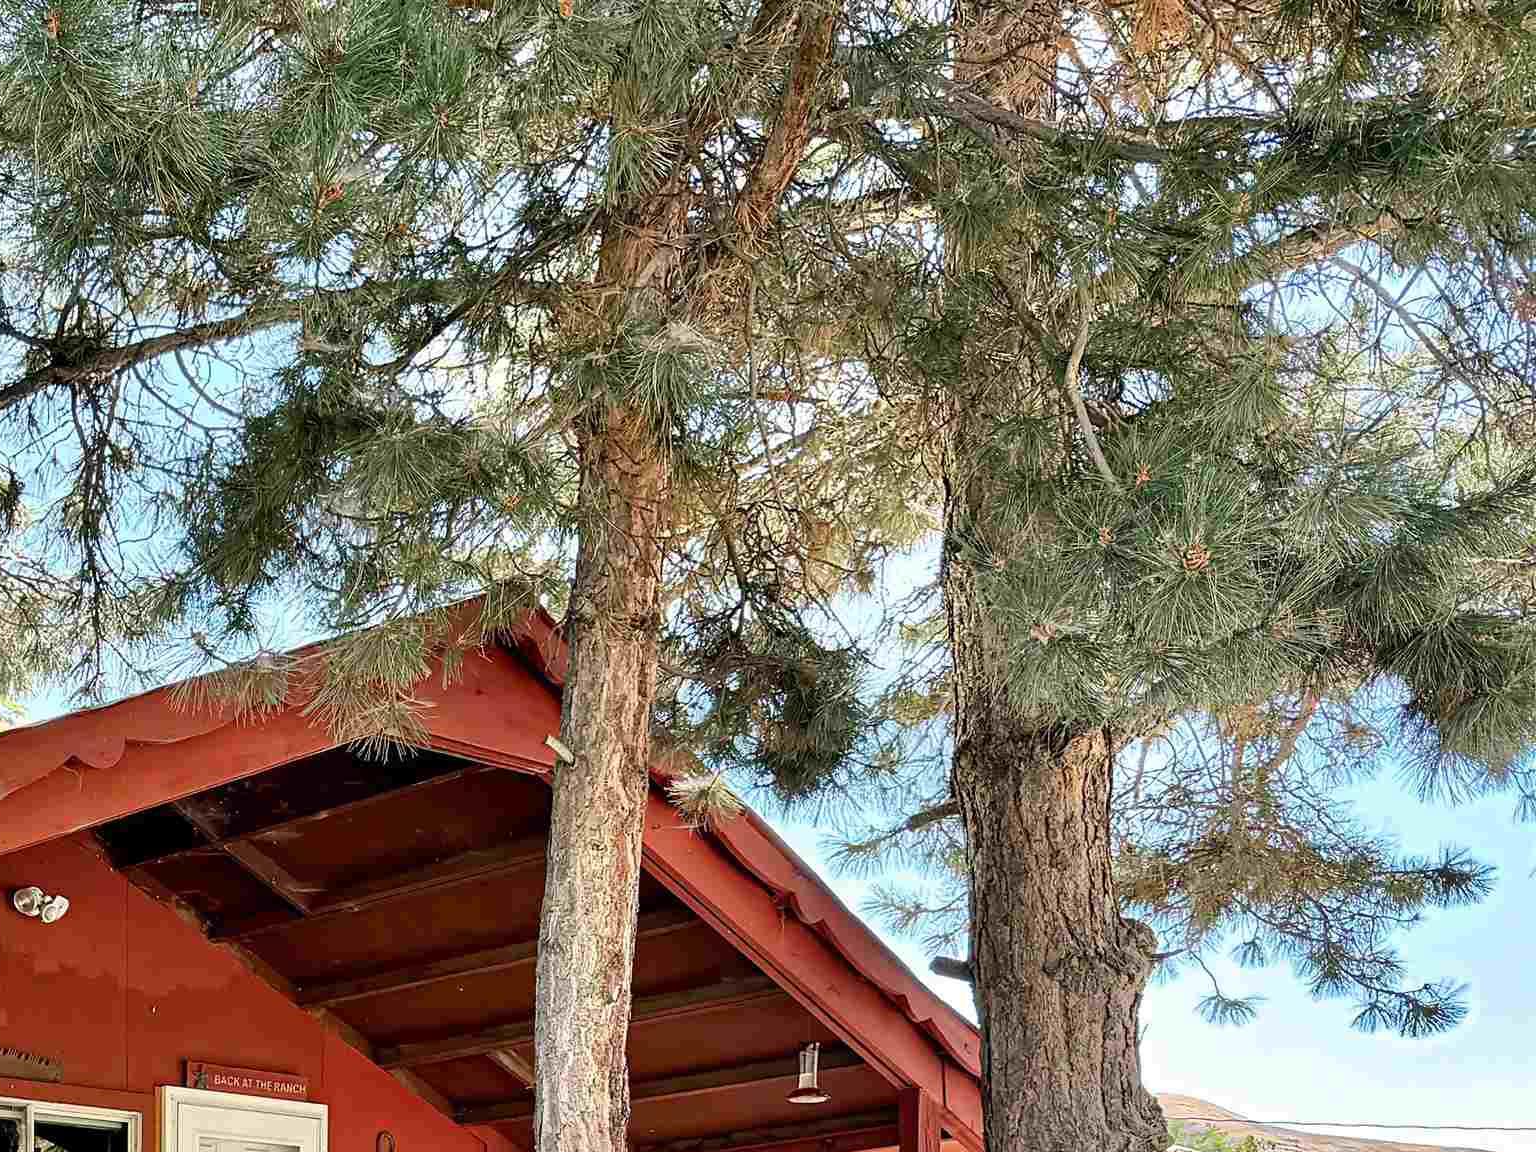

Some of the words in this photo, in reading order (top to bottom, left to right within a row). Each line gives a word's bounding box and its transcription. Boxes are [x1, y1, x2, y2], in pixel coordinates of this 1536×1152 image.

[213, 1074, 241, 1088] BACK
[241, 1078, 254, 1088] AT
[255, 1079, 273, 1091] THE
[273, 1081, 307, 1094] RANCH
